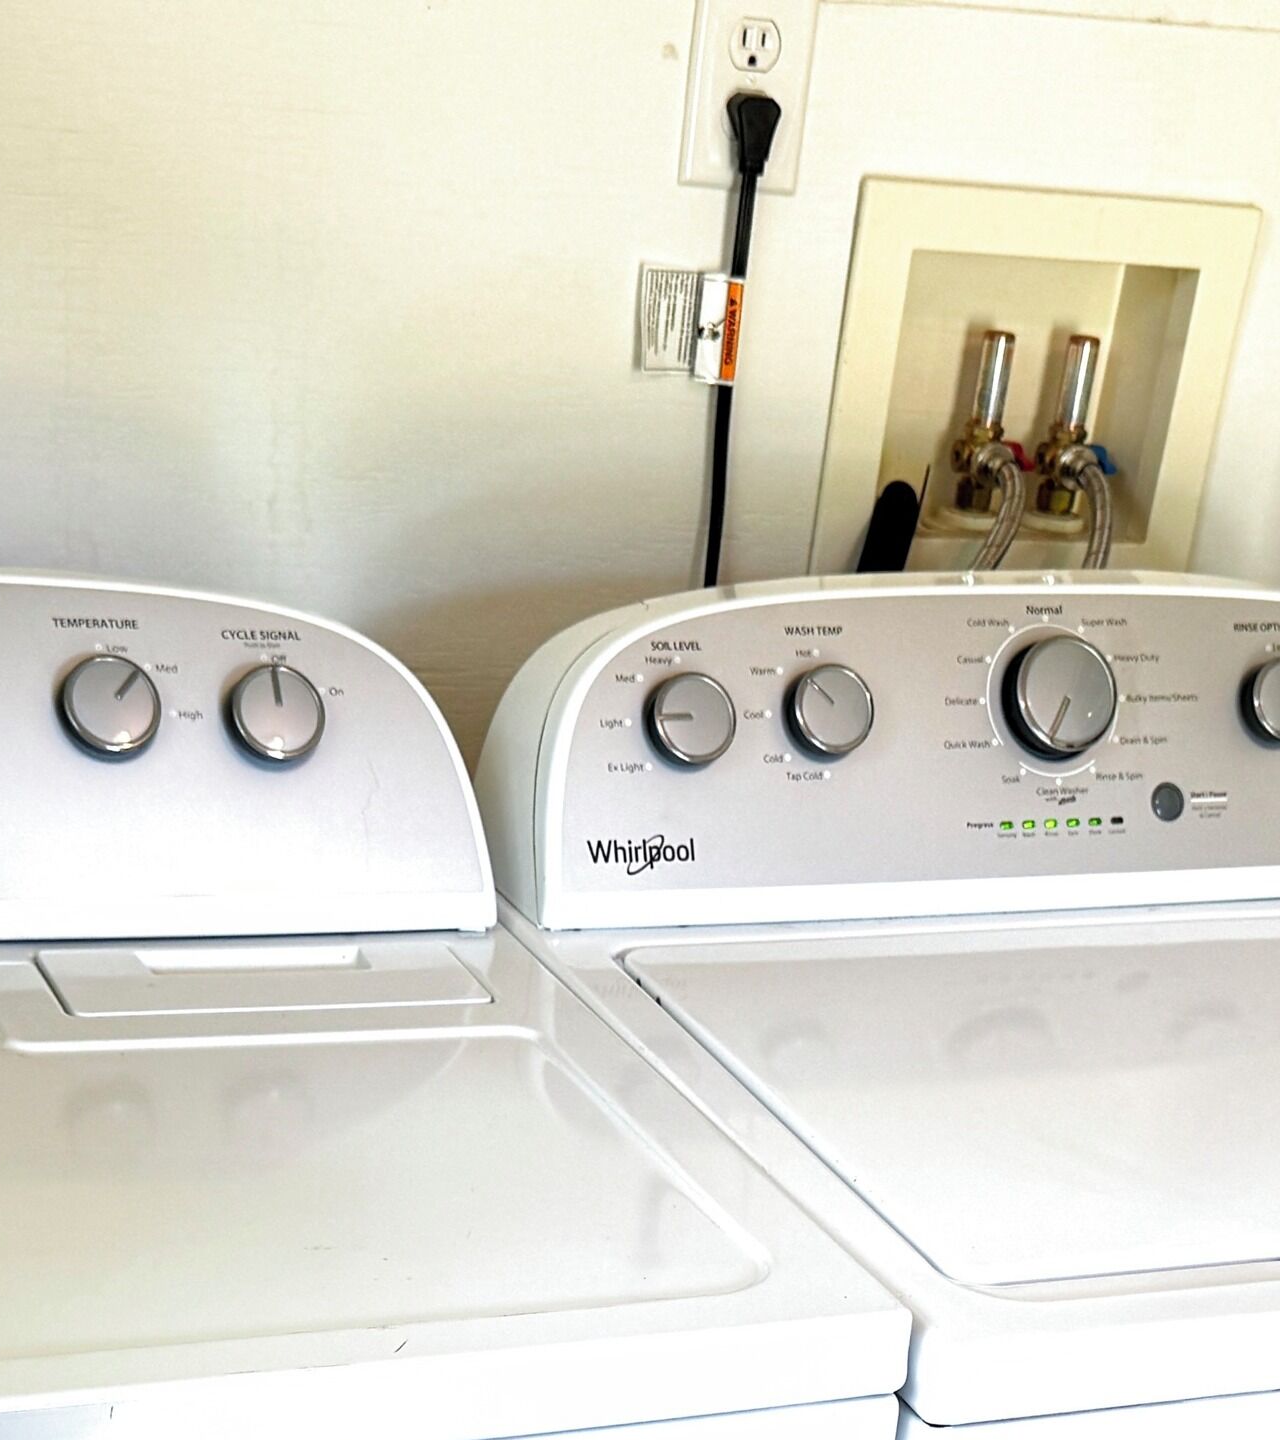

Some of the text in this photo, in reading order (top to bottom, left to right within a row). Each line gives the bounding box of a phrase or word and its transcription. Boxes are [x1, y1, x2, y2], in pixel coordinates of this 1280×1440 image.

[724, 309, 738, 366] WARNING
[1026, 606, 1063, 615] Normal
[52, 618, 138, 630] TEMPERATURE
[967, 619, 1009, 627] Cold Wash
[1081, 618, 1127, 628] Super Wash
[1234, 623, 1258, 632] RINSE
[221, 630, 301, 641] CYCLE SIGNAL
[784, 627, 843, 636] WASH TEMP
[107, 644, 128, 654] Low
[651, 641, 701, 651] SOIL LEVEL
[796, 649, 811, 657] Hot
[645, 656, 672, 665] Heavy
[957, 656, 984, 664] Casual
[1114, 654, 1159, 663] Heavy Duty
[156, 664, 178, 674] Med
[750, 667, 777, 675] Warm
[616, 674, 636, 683] Med
[329, 687, 344, 697] On
[945, 697, 977, 706] Delicate
[178, 710, 203, 721] High
[744, 710, 764, 719] Cool
[600, 719, 623, 728] Light
[944, 740, 990, 749] Quick Wash
[1120, 736, 1168, 745] Drain & Spin
[763, 754, 784, 763] Cold
[608, 763, 644, 773] Ex Light
[787, 772, 823, 781] Tap Cold
[1002, 775, 1020, 784] Soak
[1096, 772, 1143, 781] Rinse & Spin
[1036, 786, 1088, 795] Clean Washer
[586, 835, 696, 875] Whirlpool
